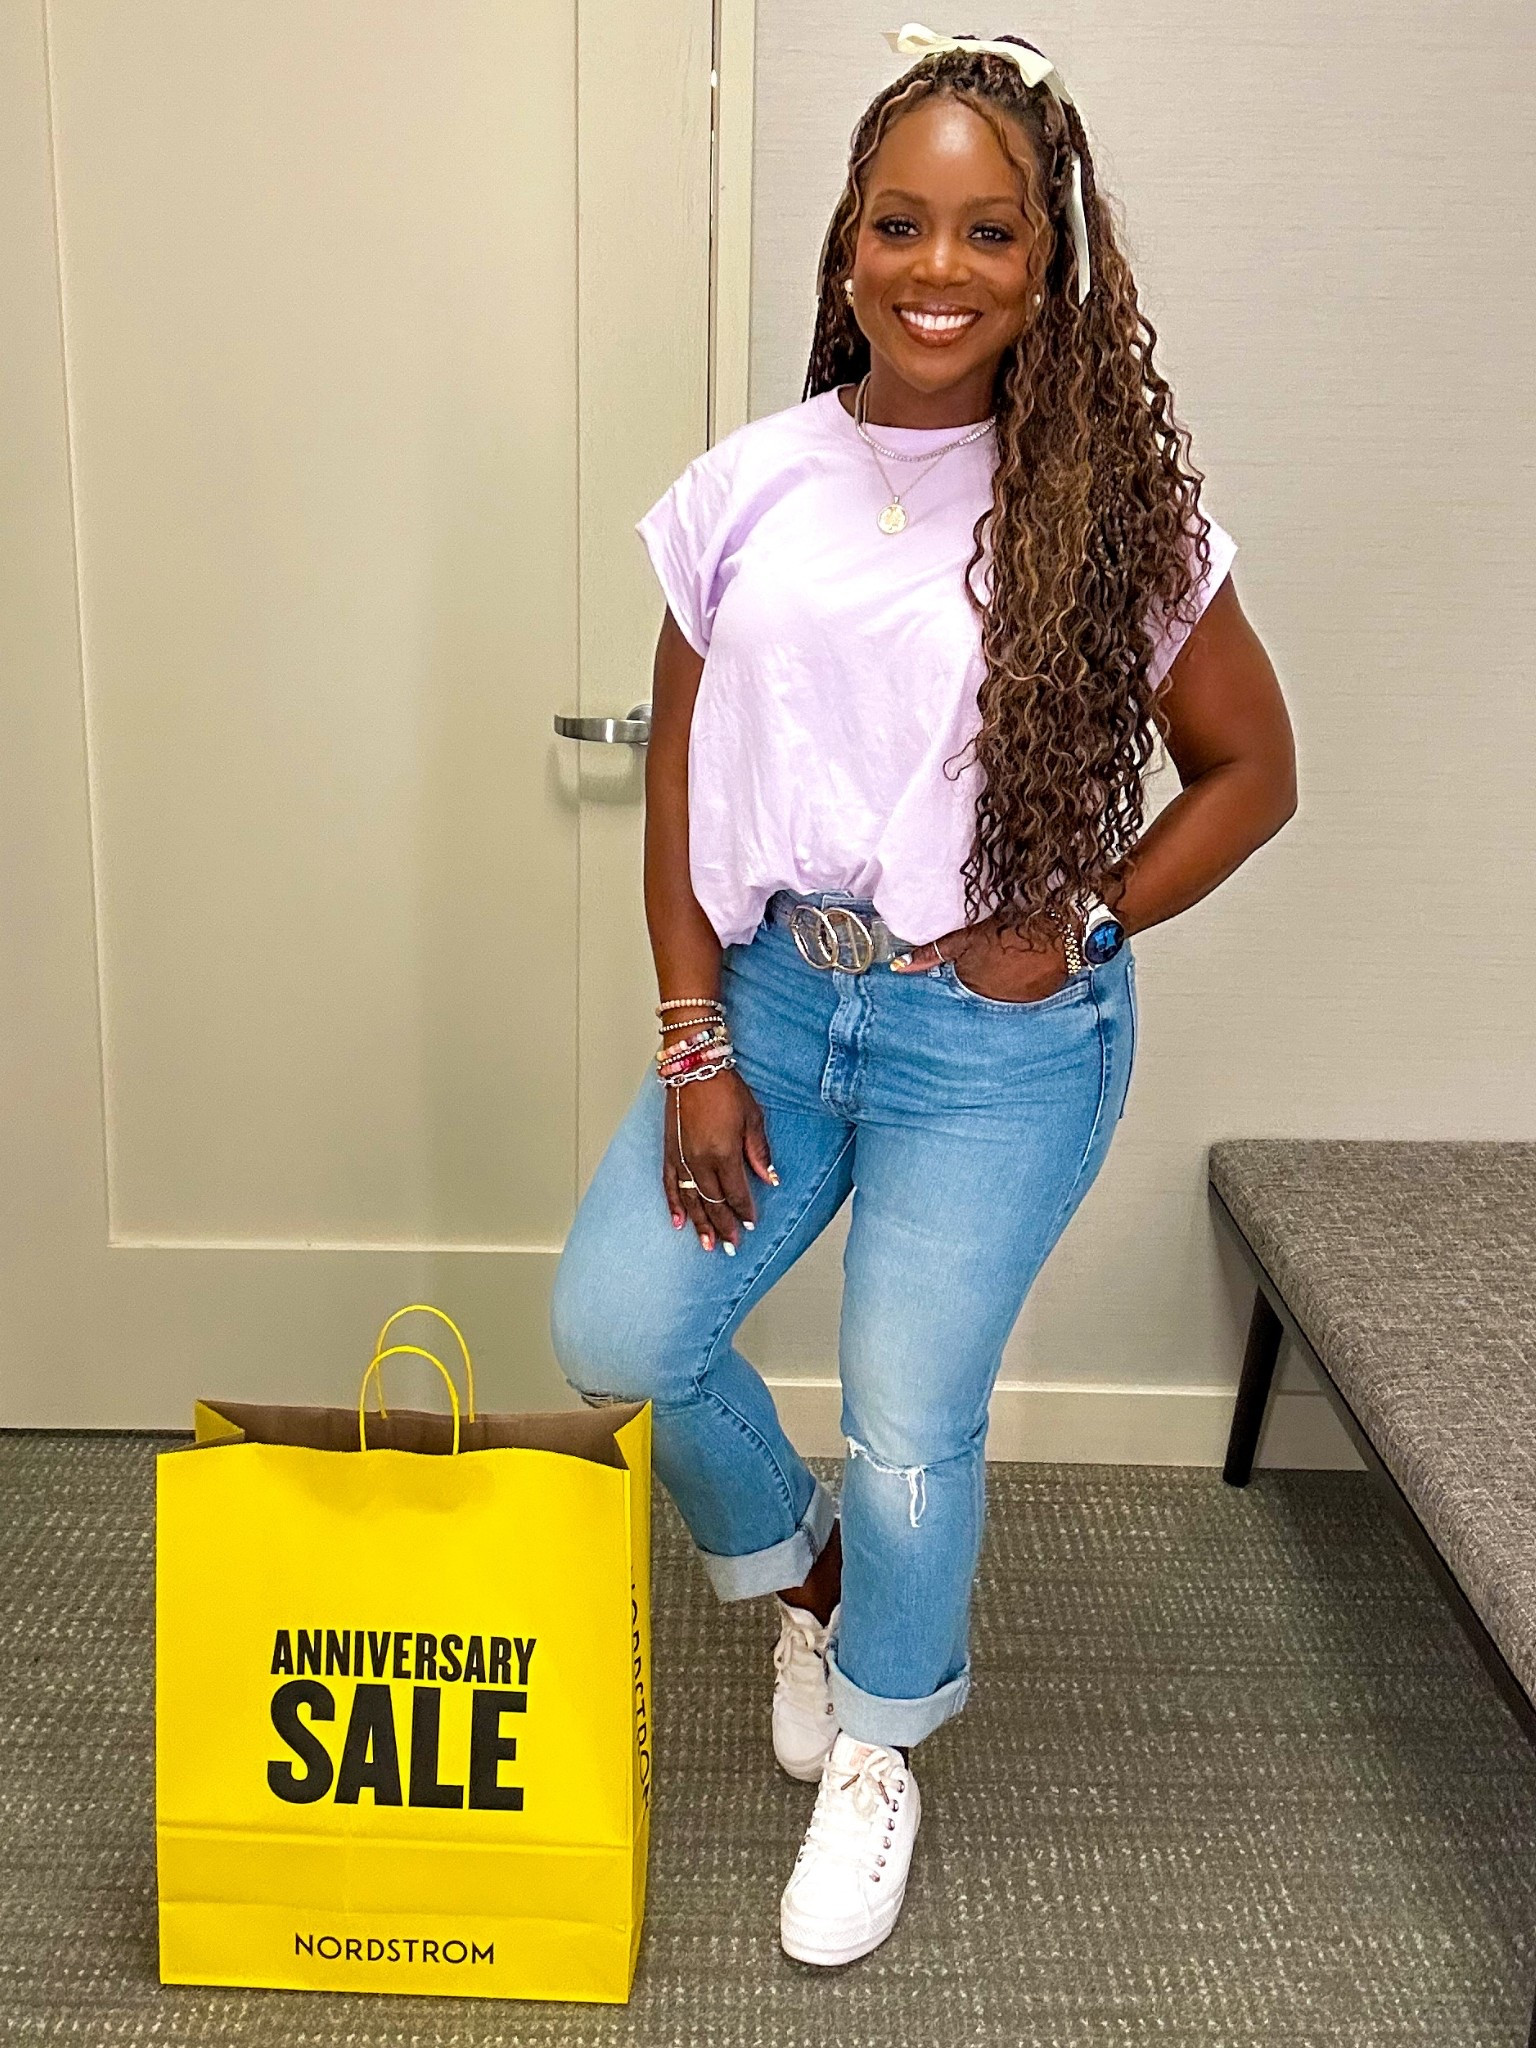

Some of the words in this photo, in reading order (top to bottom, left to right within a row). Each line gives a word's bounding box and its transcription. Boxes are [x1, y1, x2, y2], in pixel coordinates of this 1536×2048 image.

[270, 1629, 537, 1685] ANNIVERSARY
[267, 1679, 528, 1811] SALE
[295, 1932, 495, 1965] NORDSTROM
